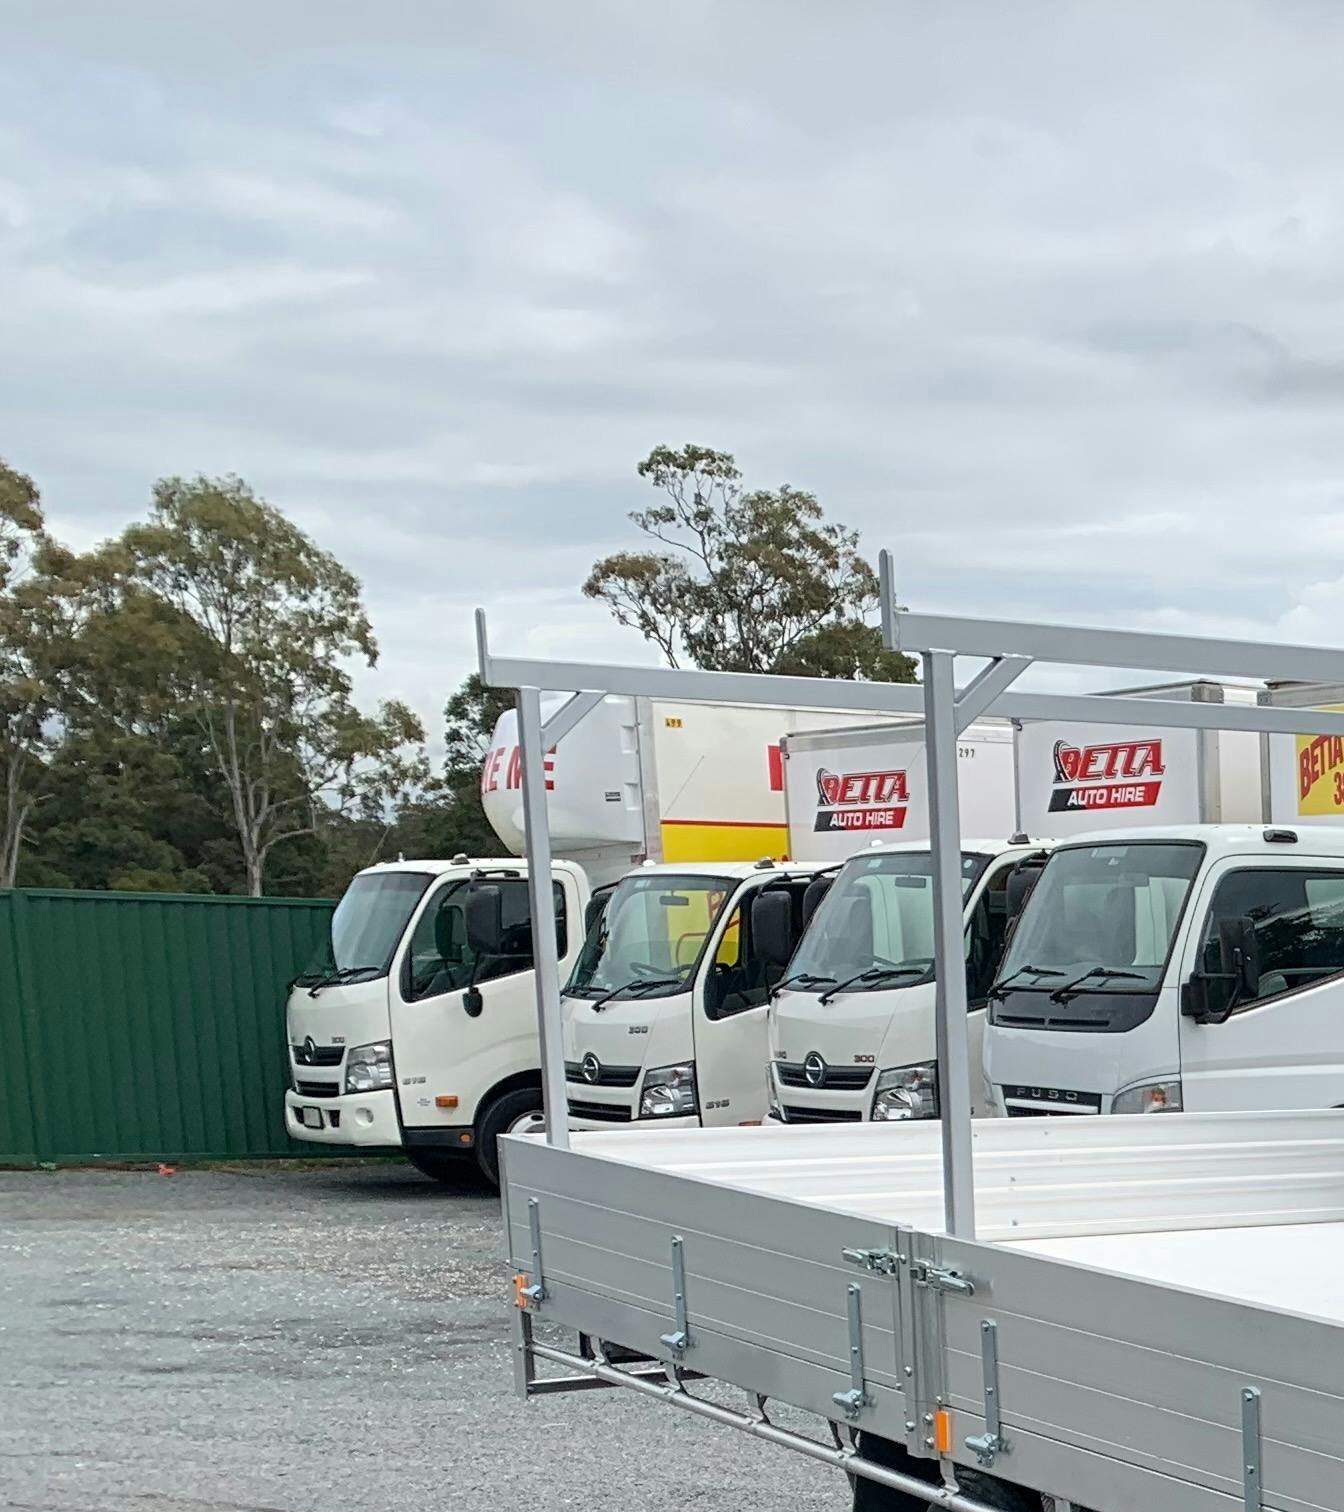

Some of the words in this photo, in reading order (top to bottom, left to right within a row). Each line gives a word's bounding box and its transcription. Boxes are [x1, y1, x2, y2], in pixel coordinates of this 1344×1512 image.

[1052, 739, 1166, 784] BETTA
[816, 768, 910, 807] BETTA
[1066, 788, 1108, 807] AUTO
[1110, 786, 1146, 804] HIRE
[829, 812, 863, 828] AUTO
[865, 810, 894, 826] HIRE
[1016, 1087, 1078, 1101] FUSO
